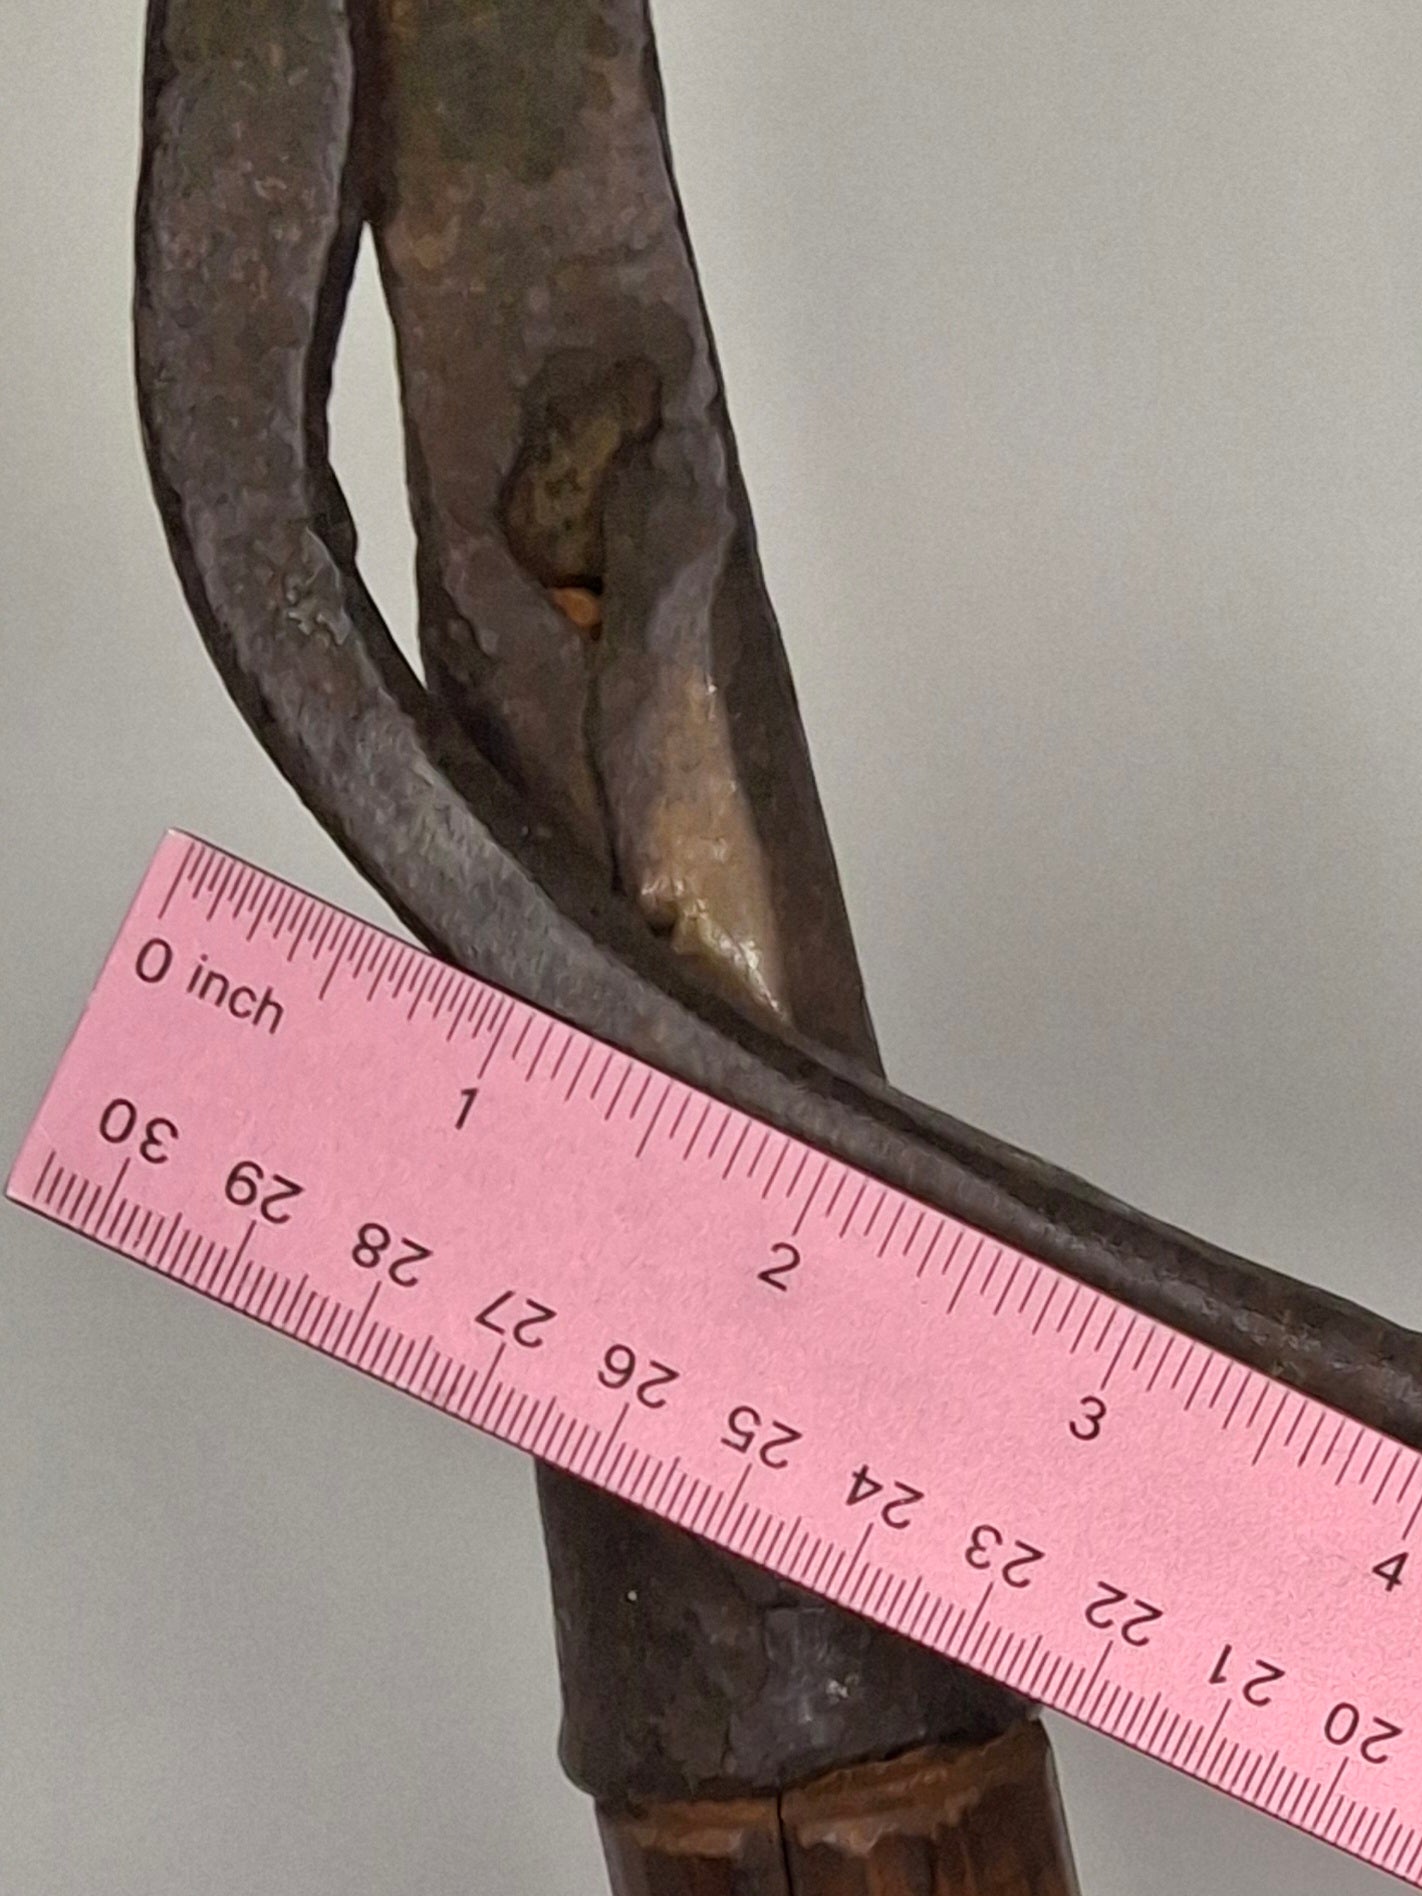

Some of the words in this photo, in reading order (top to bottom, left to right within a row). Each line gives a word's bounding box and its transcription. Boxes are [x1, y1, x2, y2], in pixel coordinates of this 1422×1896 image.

[98, 1097, 179, 1165] 30
[224, 1160, 305, 1225] 29
[135, 937, 174, 984] 0
[186, 953, 285, 1035] inch
[454, 1087, 480, 1131] 1
[756, 1241, 801, 1293] 2
[1068, 1395, 1107, 1442] 3
[1371, 1551, 1410, 1593] 4
[351, 1222, 434, 1288] 28
[474, 1289, 558, 1349] 27
[597, 1343, 681, 1410] 26
[720, 1405, 803, 1470] 25
[845, 1464, 925, 1530] 24
[964, 1524, 1046, 1589] 23
[1084, 1580, 1164, 1648] 22
[1208, 1643, 1286, 1708] 21
[1323, 1701, 1404, 1765] 20
